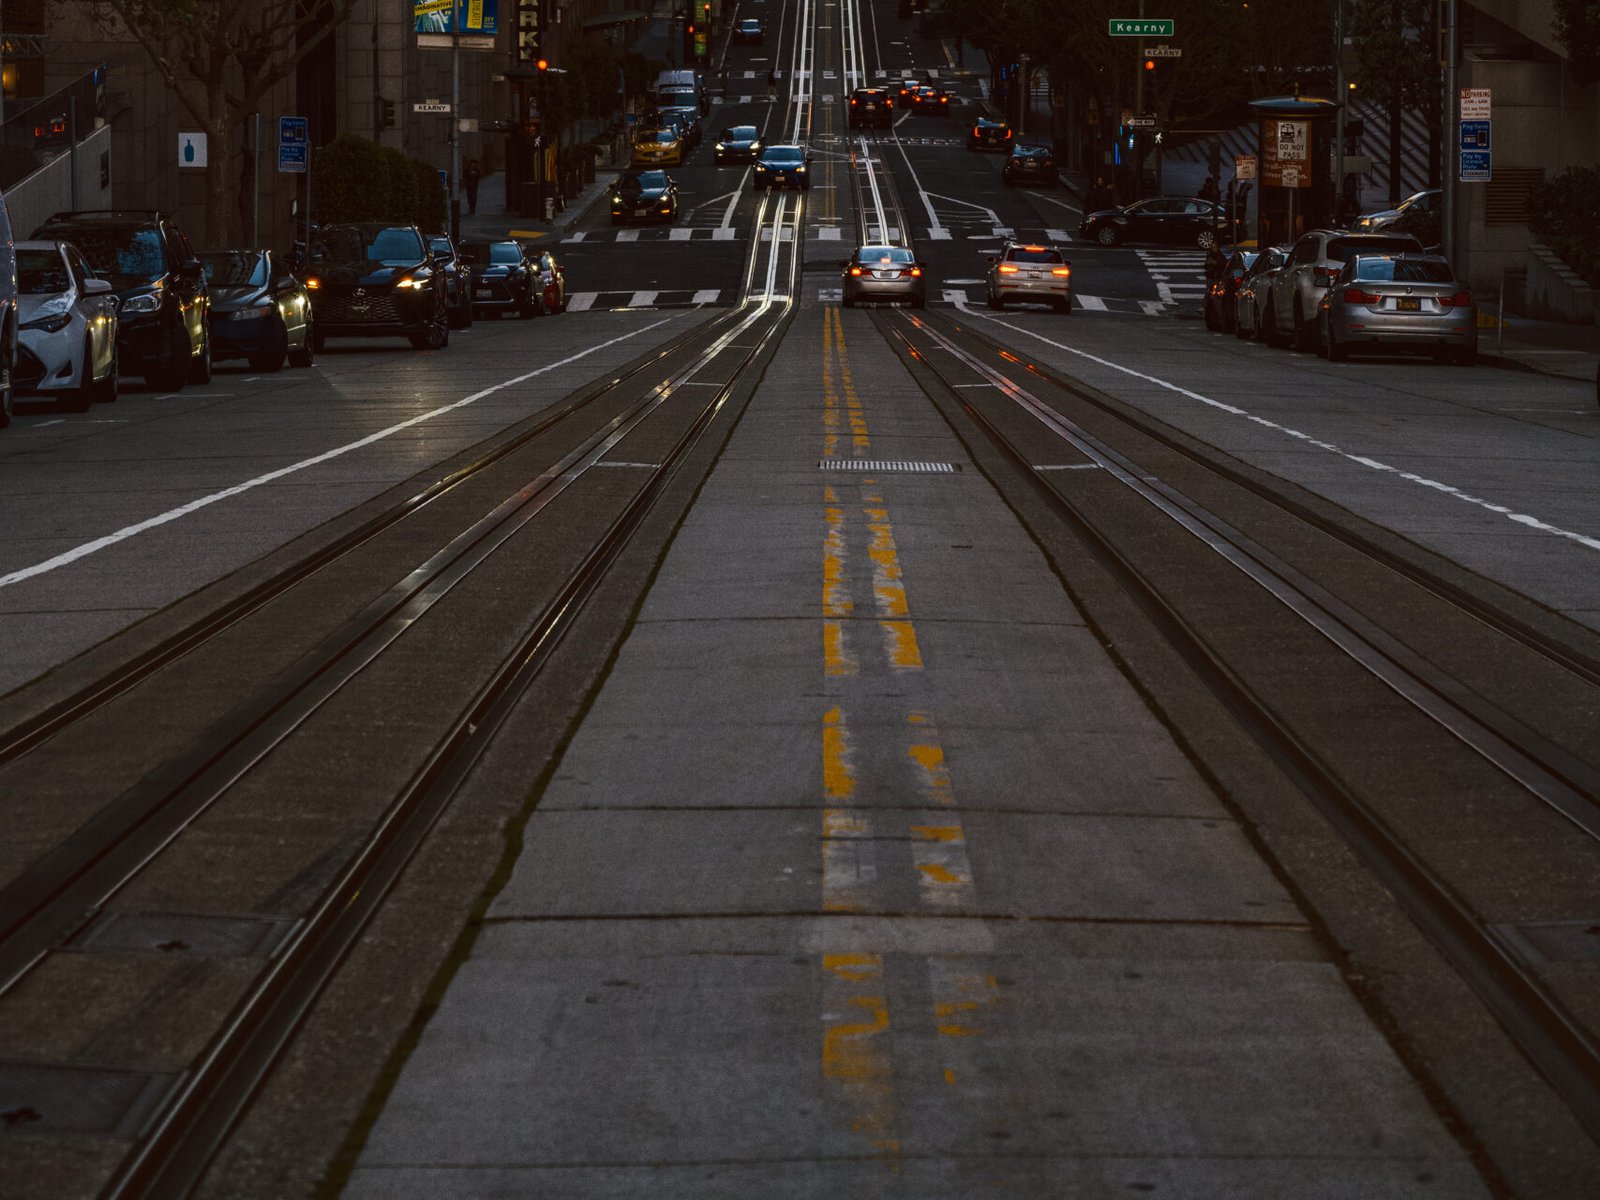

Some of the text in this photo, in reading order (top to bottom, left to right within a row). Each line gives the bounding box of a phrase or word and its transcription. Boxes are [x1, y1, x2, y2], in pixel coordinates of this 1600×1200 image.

[1116, 23, 1166, 34] Kearny
[1461, 88, 1471, 98] NO
[1462, 123, 1473, 131] Pay
